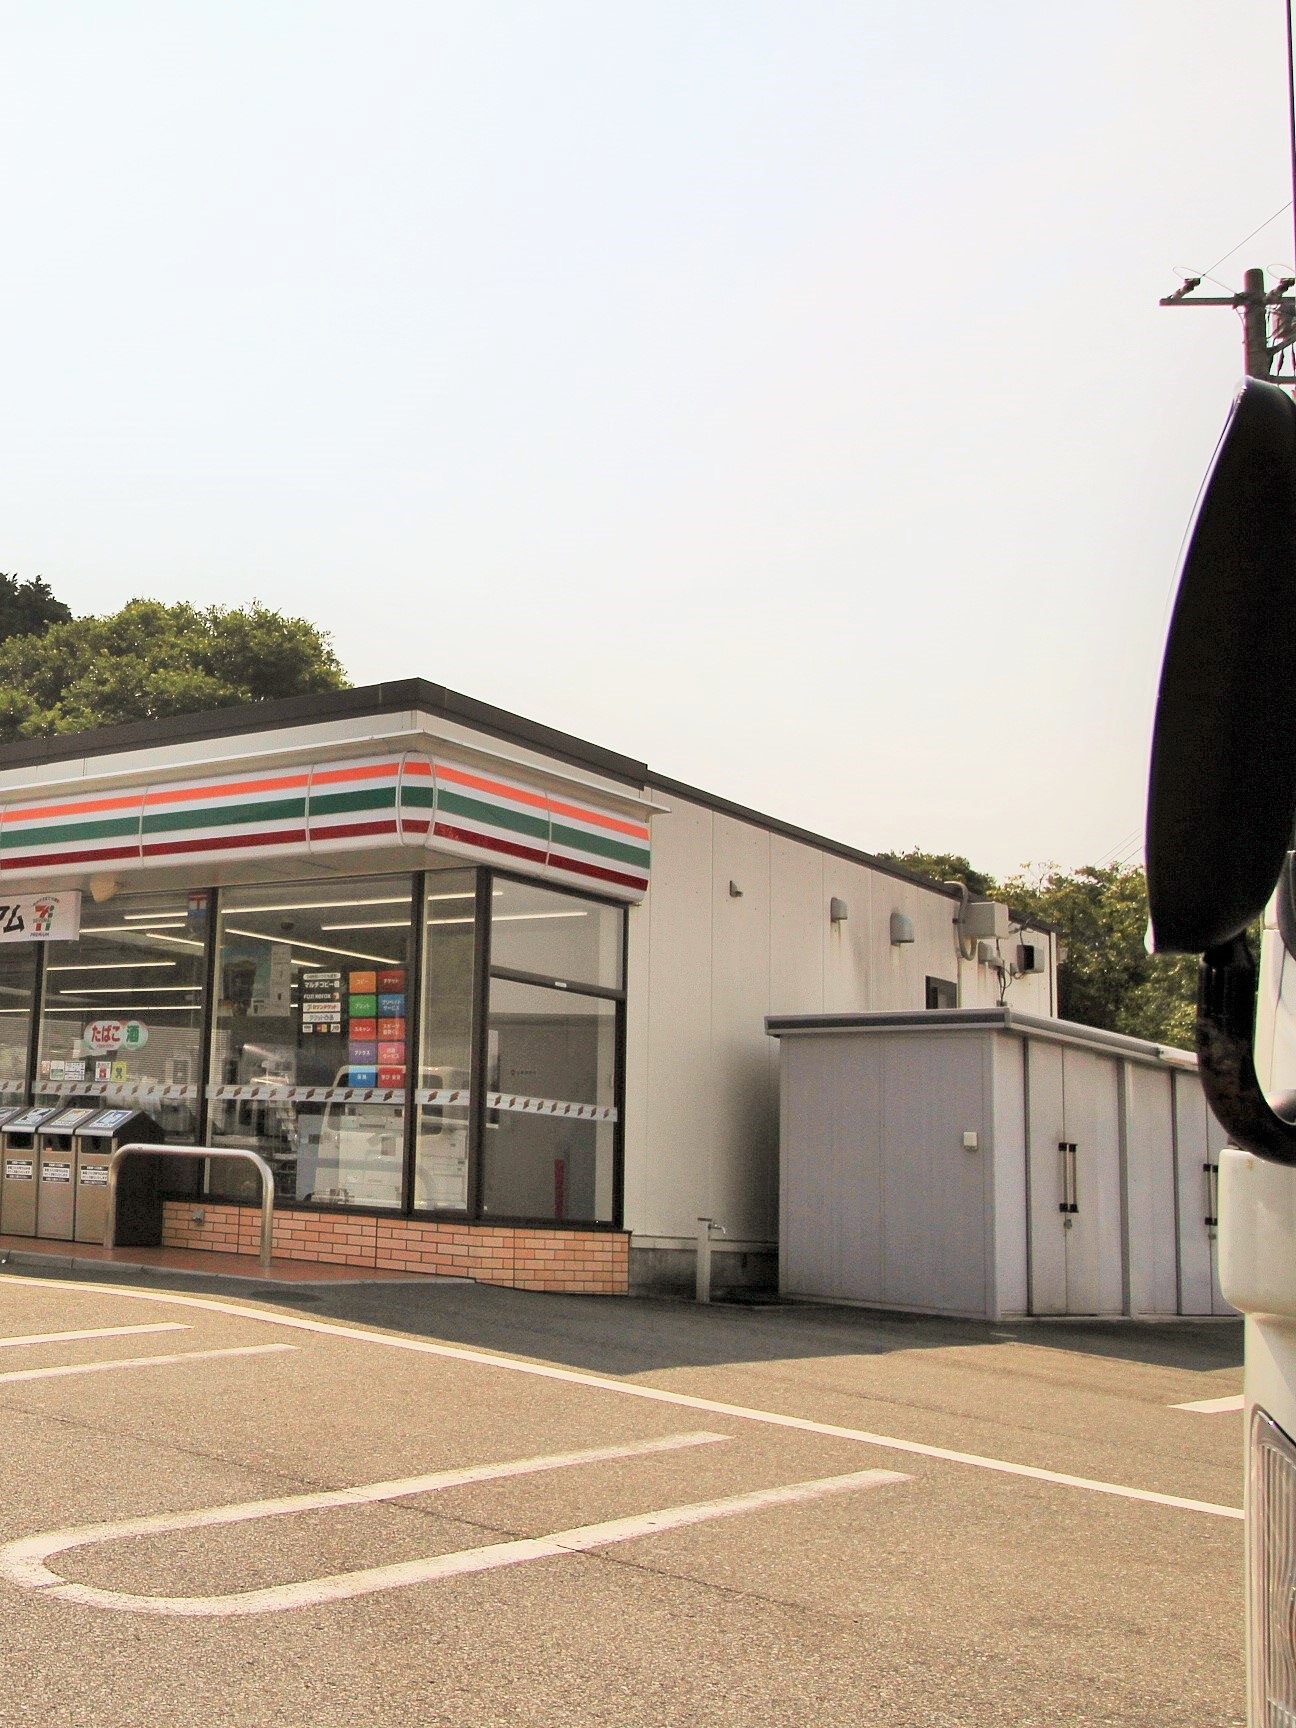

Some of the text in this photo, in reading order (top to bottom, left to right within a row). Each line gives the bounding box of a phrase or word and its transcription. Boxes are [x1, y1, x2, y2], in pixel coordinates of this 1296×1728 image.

[91, 1024, 140, 1043] たばこ 酒
